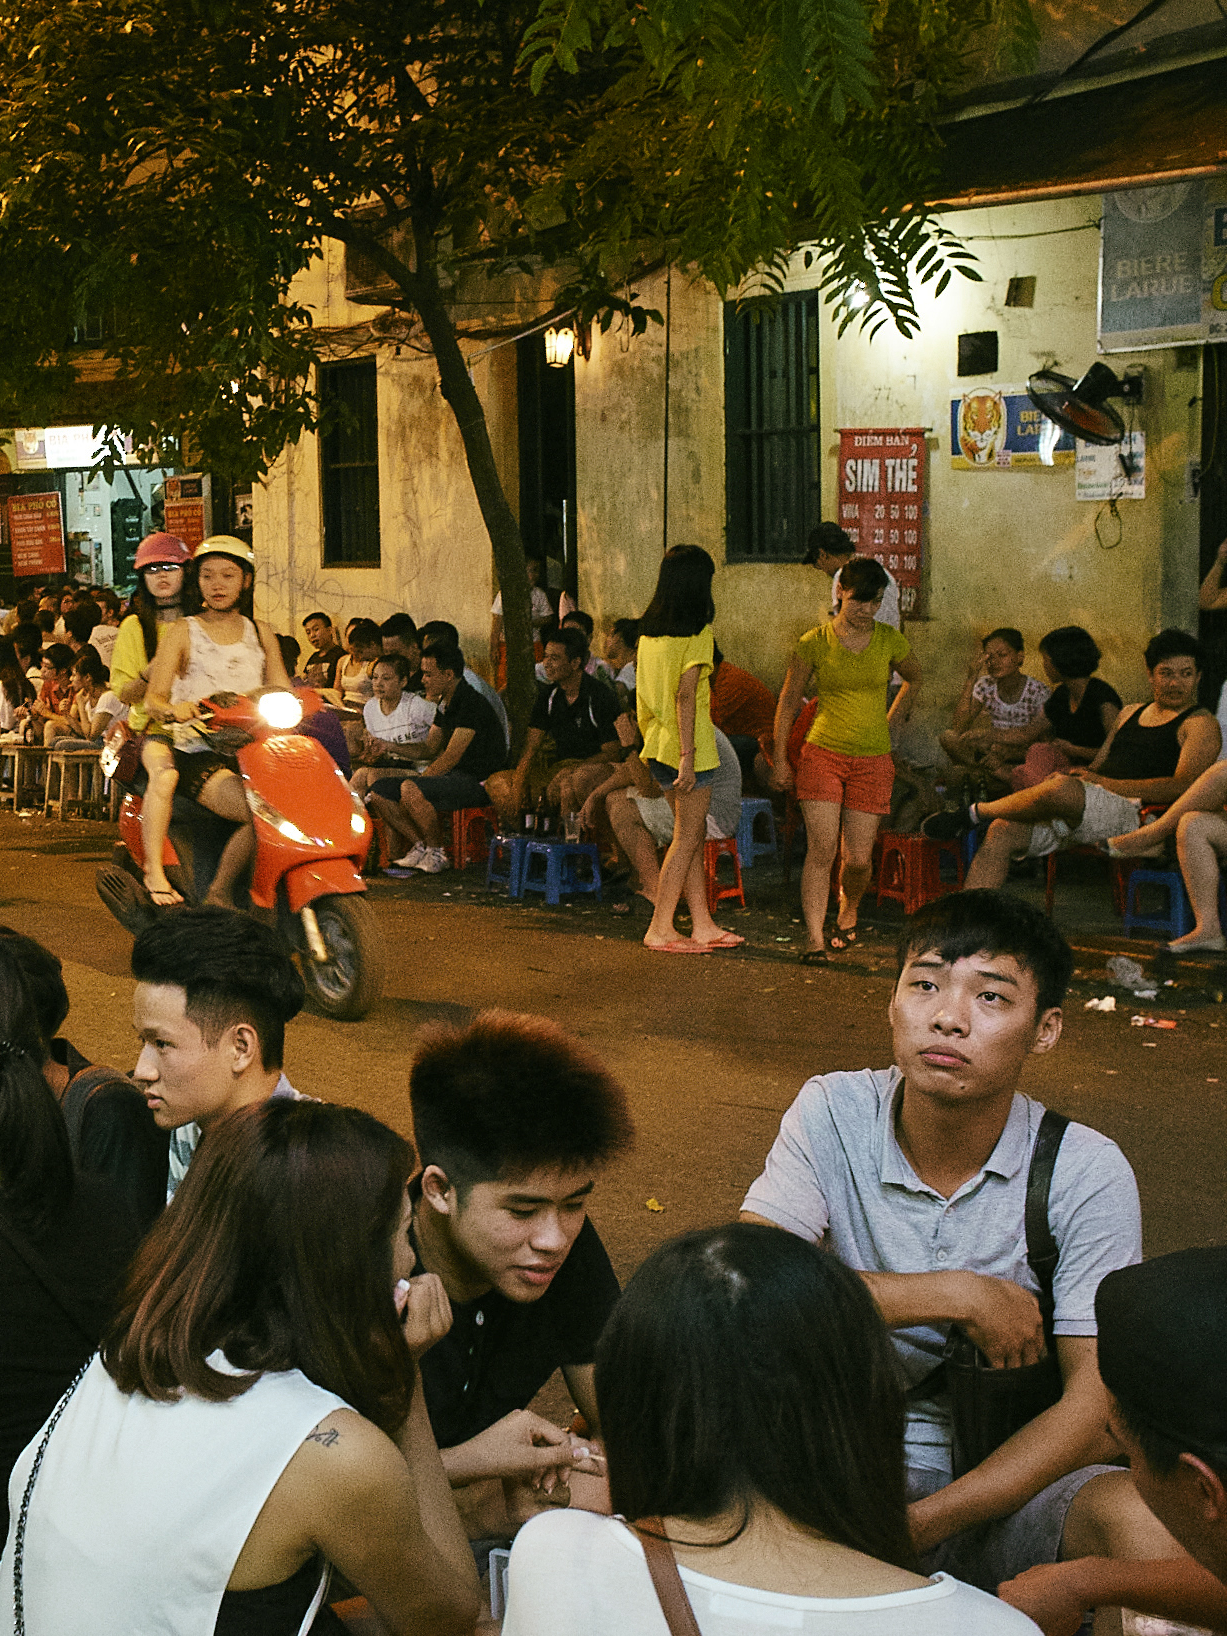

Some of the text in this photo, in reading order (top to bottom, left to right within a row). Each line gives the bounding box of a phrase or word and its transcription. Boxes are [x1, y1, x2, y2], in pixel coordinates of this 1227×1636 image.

[845, 458, 880, 493] SIM
[874, 504, 885, 519] 20
[890, 504, 900, 519] 50
[904, 504, 918, 520] 100
[874, 529, 884, 544] 20
[889, 529, 899, 544] 50
[904, 529, 917, 545] 100
[889, 554, 899, 569] 50
[904, 555, 917, 570] 100
